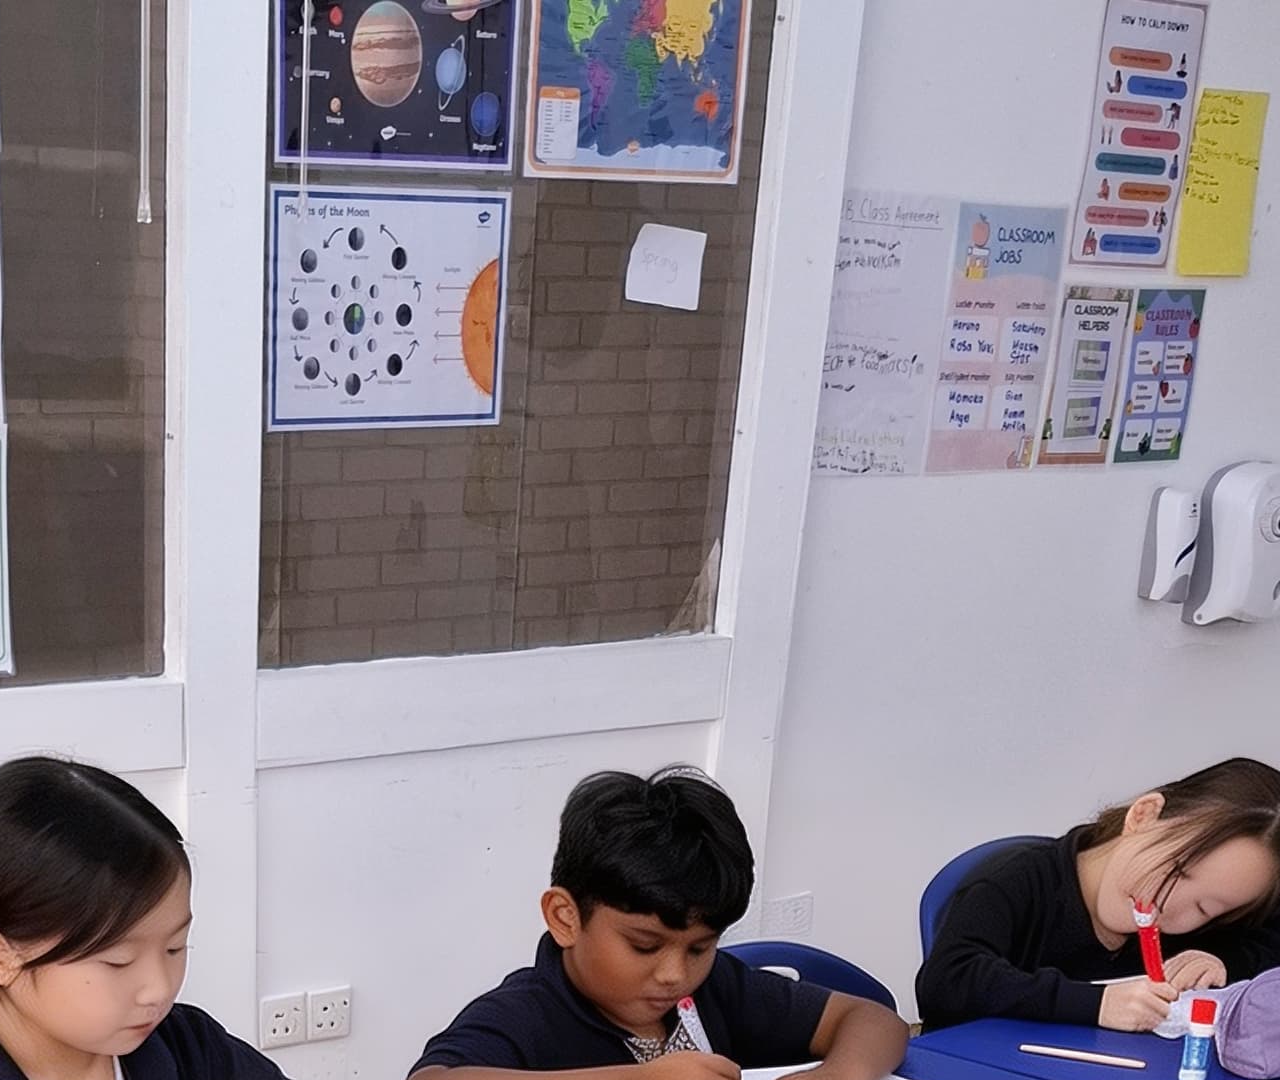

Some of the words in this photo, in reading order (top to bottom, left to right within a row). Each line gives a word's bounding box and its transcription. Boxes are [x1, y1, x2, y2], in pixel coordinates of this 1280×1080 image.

[1121, 16, 1135, 25] HOW
[1148, 19, 1166, 29] CALM
[330, 206, 344, 216] the
[347, 207, 369, 217] Moon
[860, 198, 890, 221] Class
[998, 226, 1055, 244] CLASSROOM
[995, 249, 1022, 264] JOBS
[1074, 304, 1119, 317] CLASSROOM
[1078, 320, 1110, 331] HELPERS
[1155, 324, 1179, 336] RULES
